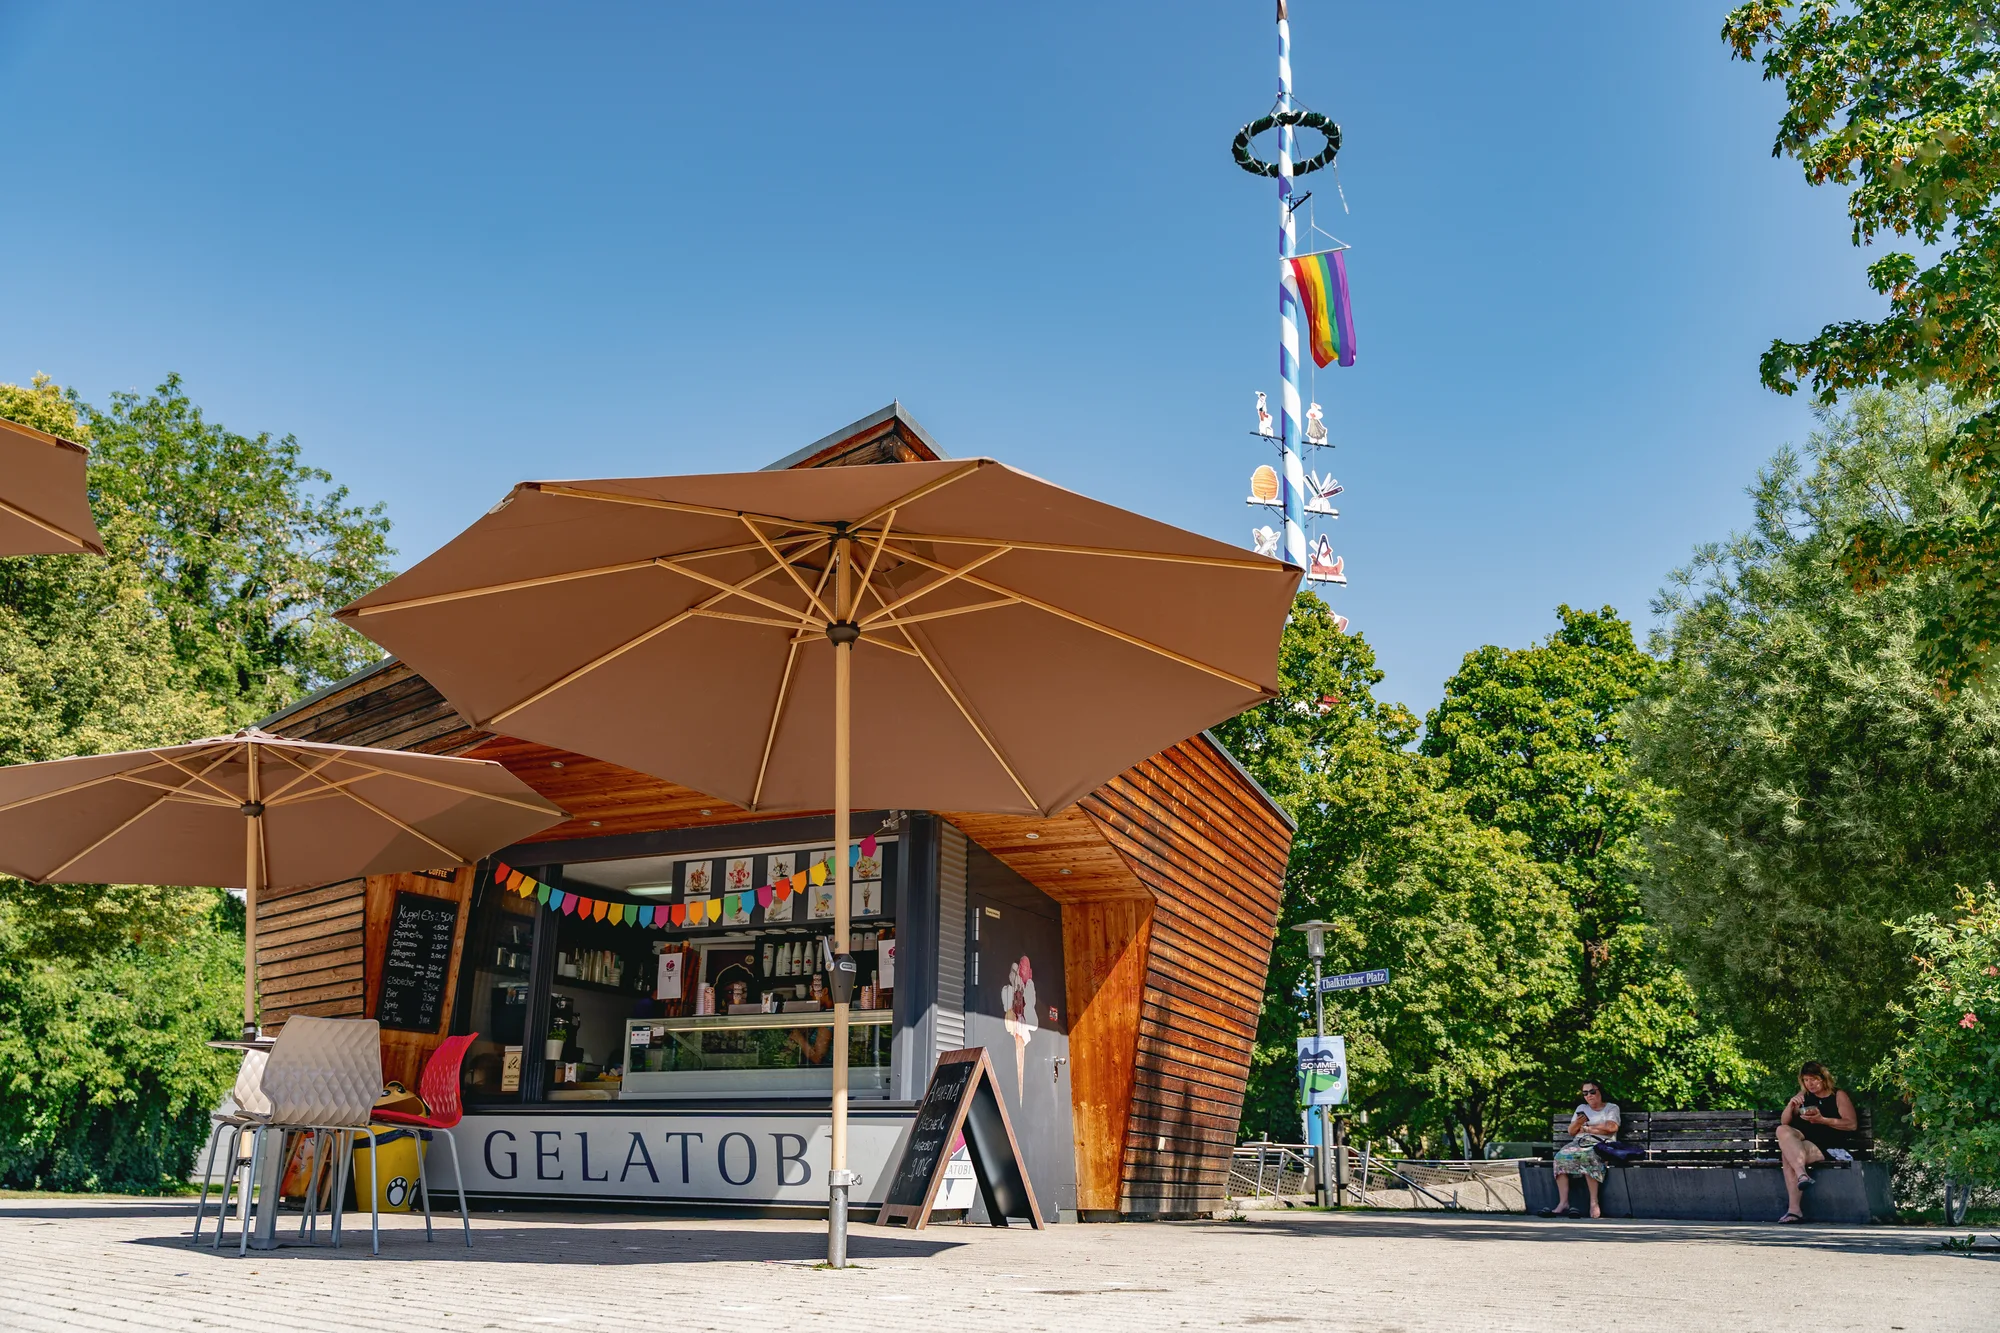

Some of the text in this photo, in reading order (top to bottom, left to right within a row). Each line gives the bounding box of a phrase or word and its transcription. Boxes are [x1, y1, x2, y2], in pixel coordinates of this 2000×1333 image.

[428, 869, 448, 878] COFFEE
[397, 904, 420, 922] Kugel
[1322, 972, 1385, 989] Thalkirchner Platz
[385, 987, 399, 998] Bier
[1300, 1061, 1343, 1070] SOMMER
[1310, 1068, 1337, 1076] FEST
[917, 1113, 947, 1132] BECHER
[912, 1138, 939, 1152] ANGEBOT
[483, 1129, 832, 1187] GELATOB
[944, 1164, 972, 1176] ATOBI
